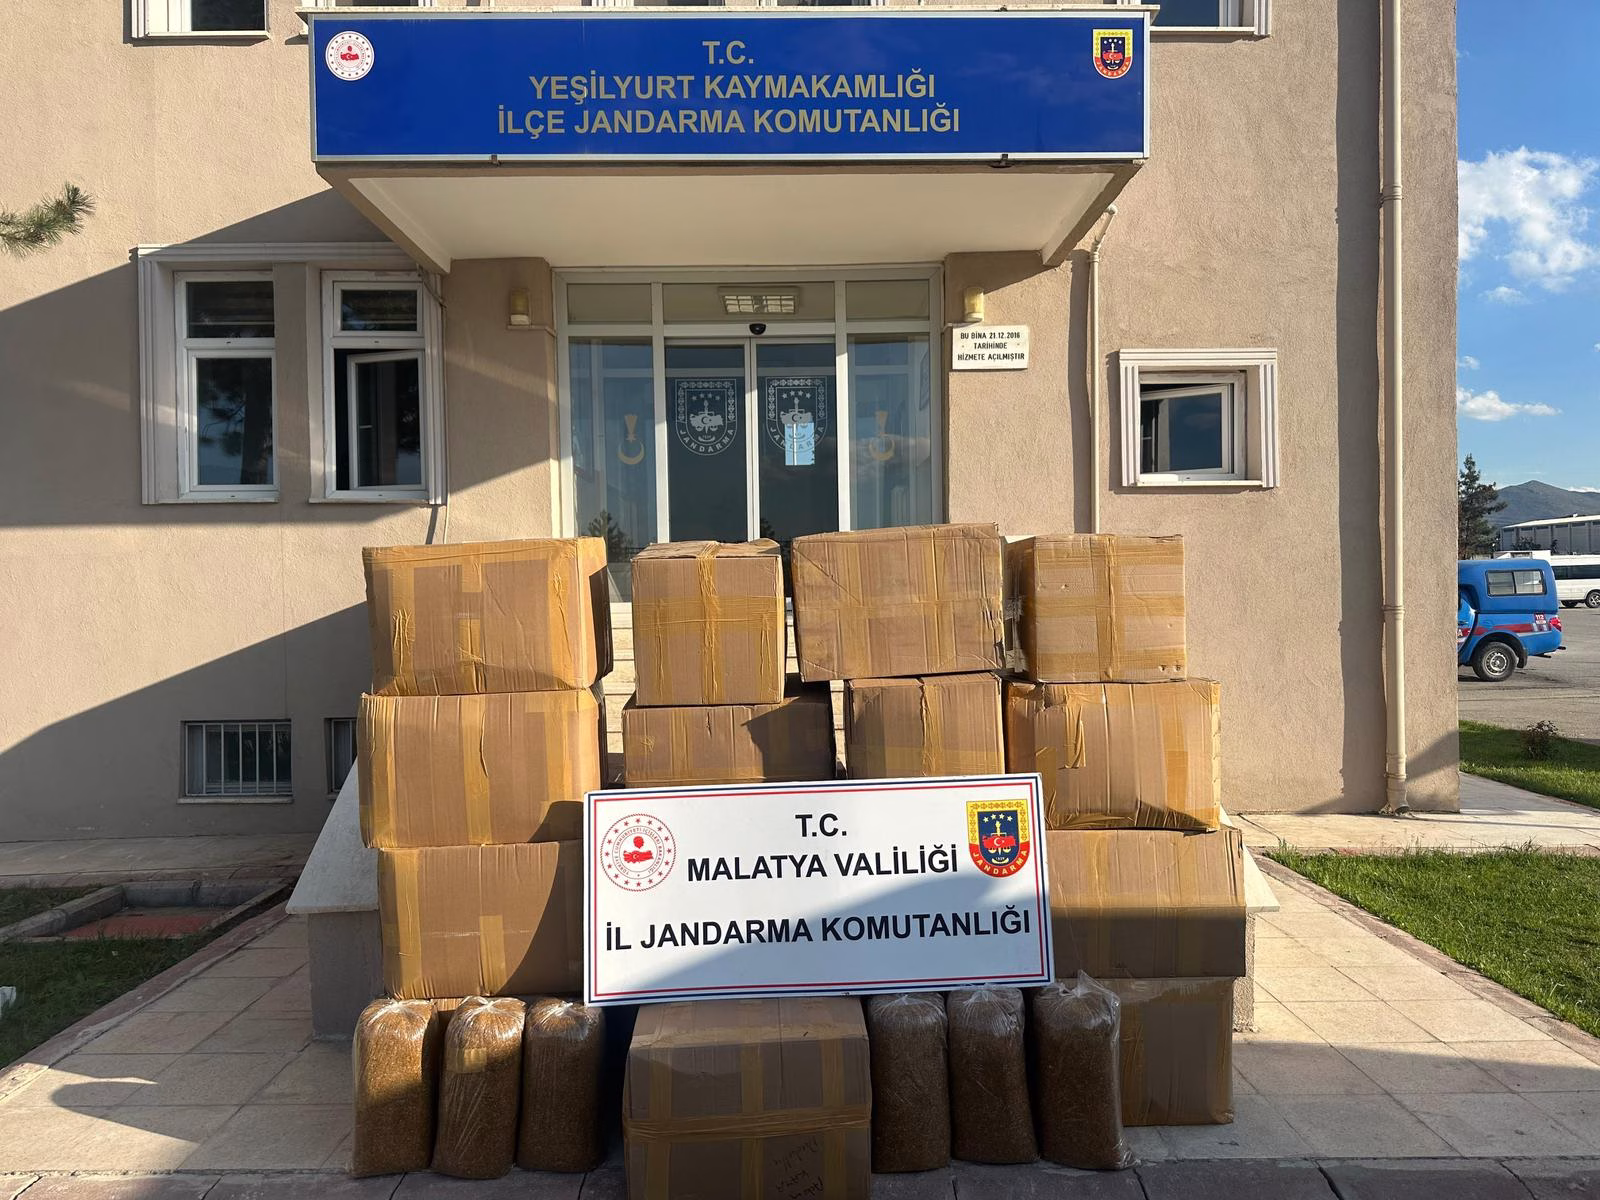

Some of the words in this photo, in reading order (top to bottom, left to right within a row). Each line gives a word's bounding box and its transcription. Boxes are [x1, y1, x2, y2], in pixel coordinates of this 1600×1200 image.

[701, 40, 754, 65] T.C.
[528, 69, 695, 105] YEŞİLYURT
[704, 67, 935, 99] KAYMAKAMLIĞI
[498, 104, 565, 140] İLÇE
[573, 109, 746, 134] JANDARMA
[753, 102, 960, 133] KOMUTANLIĞI
[960, 332, 969, 340] BU
[970, 331, 987, 339] BİNA
[973, 341, 1008, 350] TARİHİNDE
[957, 352, 986, 361] HİZMETE
[987, 352, 1025, 362] AÇILMIŞTIR
[679, 428, 734, 453] JANDARMA
[795, 812, 848, 838] T.C.
[687, 853, 825, 883] MALATYA
[834, 843, 959, 877] VALİLİĞİ
[972, 850, 1028, 875] JANDARMA
[605, 920, 632, 951] İL
[639, 917, 814, 949] JANDARMA
[820, 904, 1031, 942] KOMUTANLIĞI
